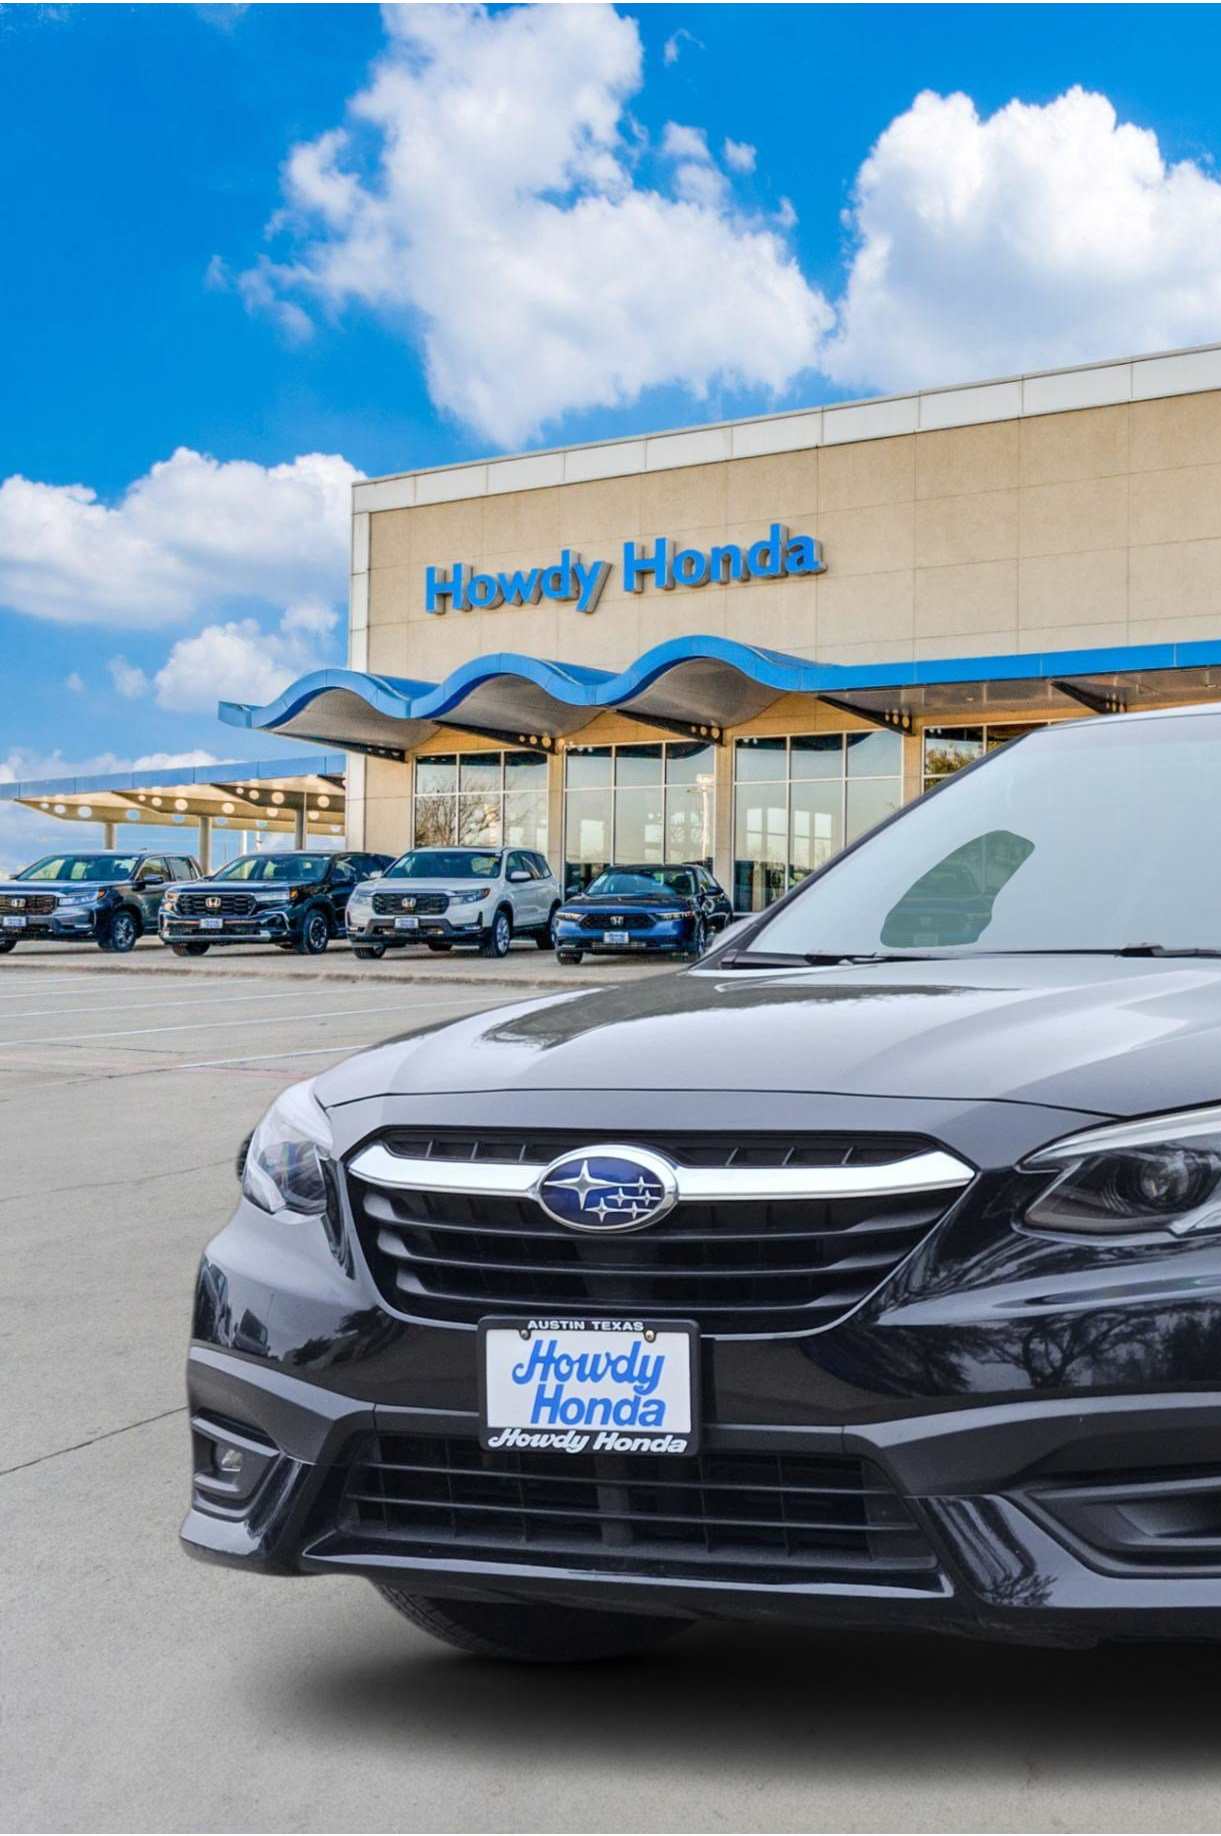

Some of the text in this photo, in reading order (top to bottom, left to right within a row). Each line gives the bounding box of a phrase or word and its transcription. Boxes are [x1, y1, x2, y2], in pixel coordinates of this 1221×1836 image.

[425, 523, 827, 615] Howdy Honda
[527, 1319, 644, 1332] AUSTIN TEXAS
[511, 1339, 665, 1396] Howdy
[530, 1383, 666, 1427] Honda
[487, 1427, 688, 1454] Howdy Honda
